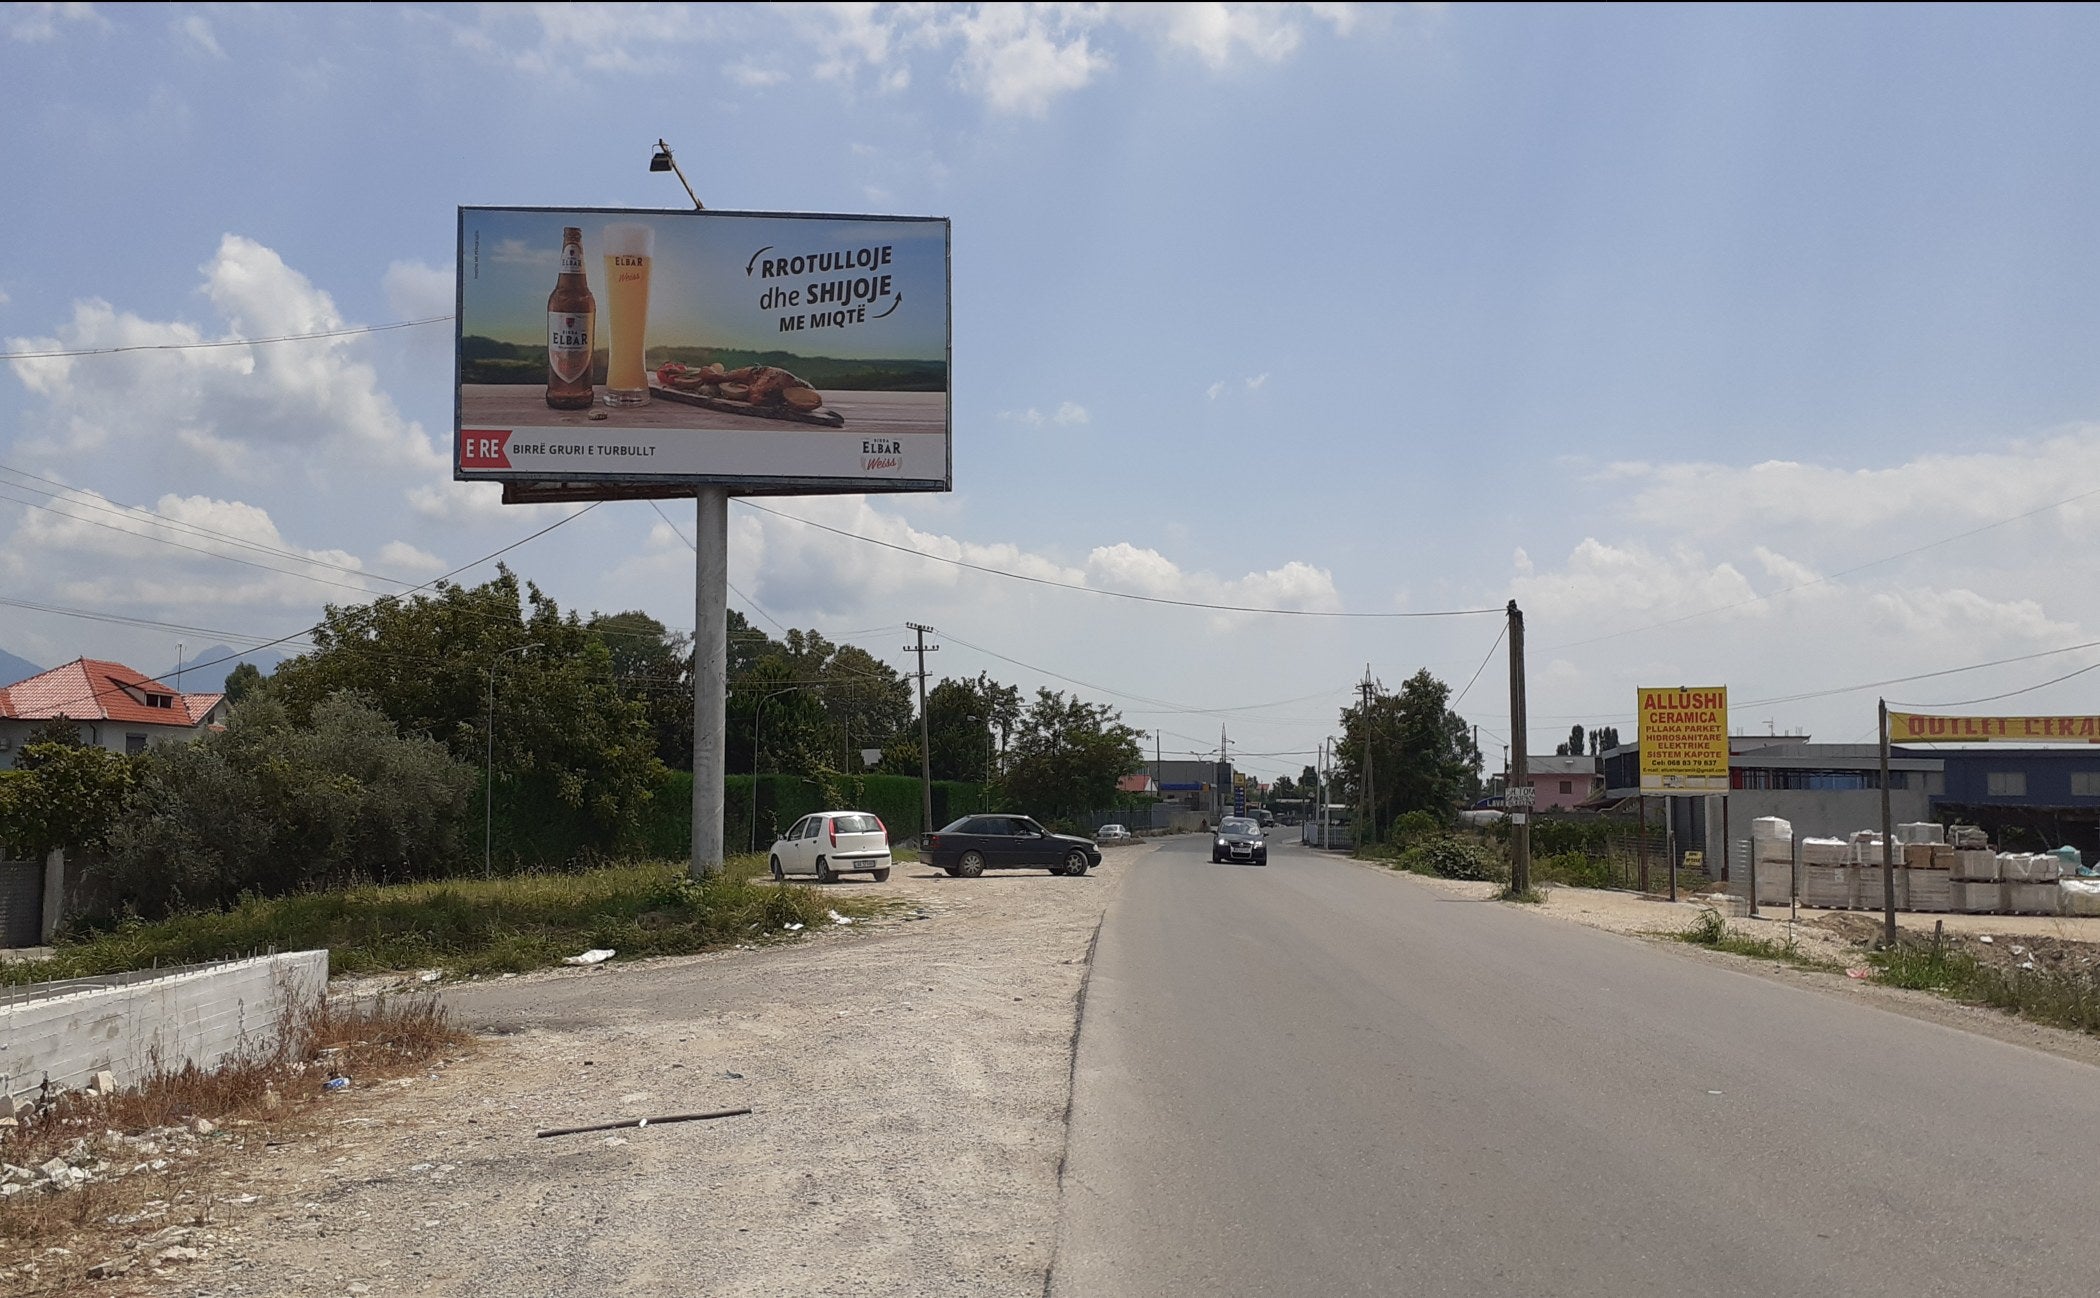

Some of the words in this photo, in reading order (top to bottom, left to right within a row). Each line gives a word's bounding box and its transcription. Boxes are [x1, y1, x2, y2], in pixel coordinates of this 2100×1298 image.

[615, 256, 643, 266] ELBAR
[762, 246, 892, 278] RROTULLOJE
[760, 287, 800, 310] dhe
[807, 275, 892, 306] SHIJOJE
[779, 315, 805, 332] ME
[810, 304, 866, 329] MIQTË
[553, 332, 588, 345] ELBAR
[466, 438, 475, 458] E
[480, 439, 499, 459] RE
[513, 443, 546, 455] BIRRË
[549, 444, 585, 456] GRURI
[588, 445, 594, 455] E
[597, 445, 656, 456] TURBULLT
[862, 441, 902, 454] ELBAR
[867, 457, 897, 471] Weiss
[1644, 693, 1723, 710] ALLUSHI
[1649, 712, 1717, 724] CERAMICA
[1646, 725, 1682, 733] PLLAKA
[1684, 725, 1721, 733] PARKET
[1908, 716, 2006, 736] OUTLET
[1647, 751, 1682, 759] SISTEM
[1684, 751, 1722, 759] KAPOTE
